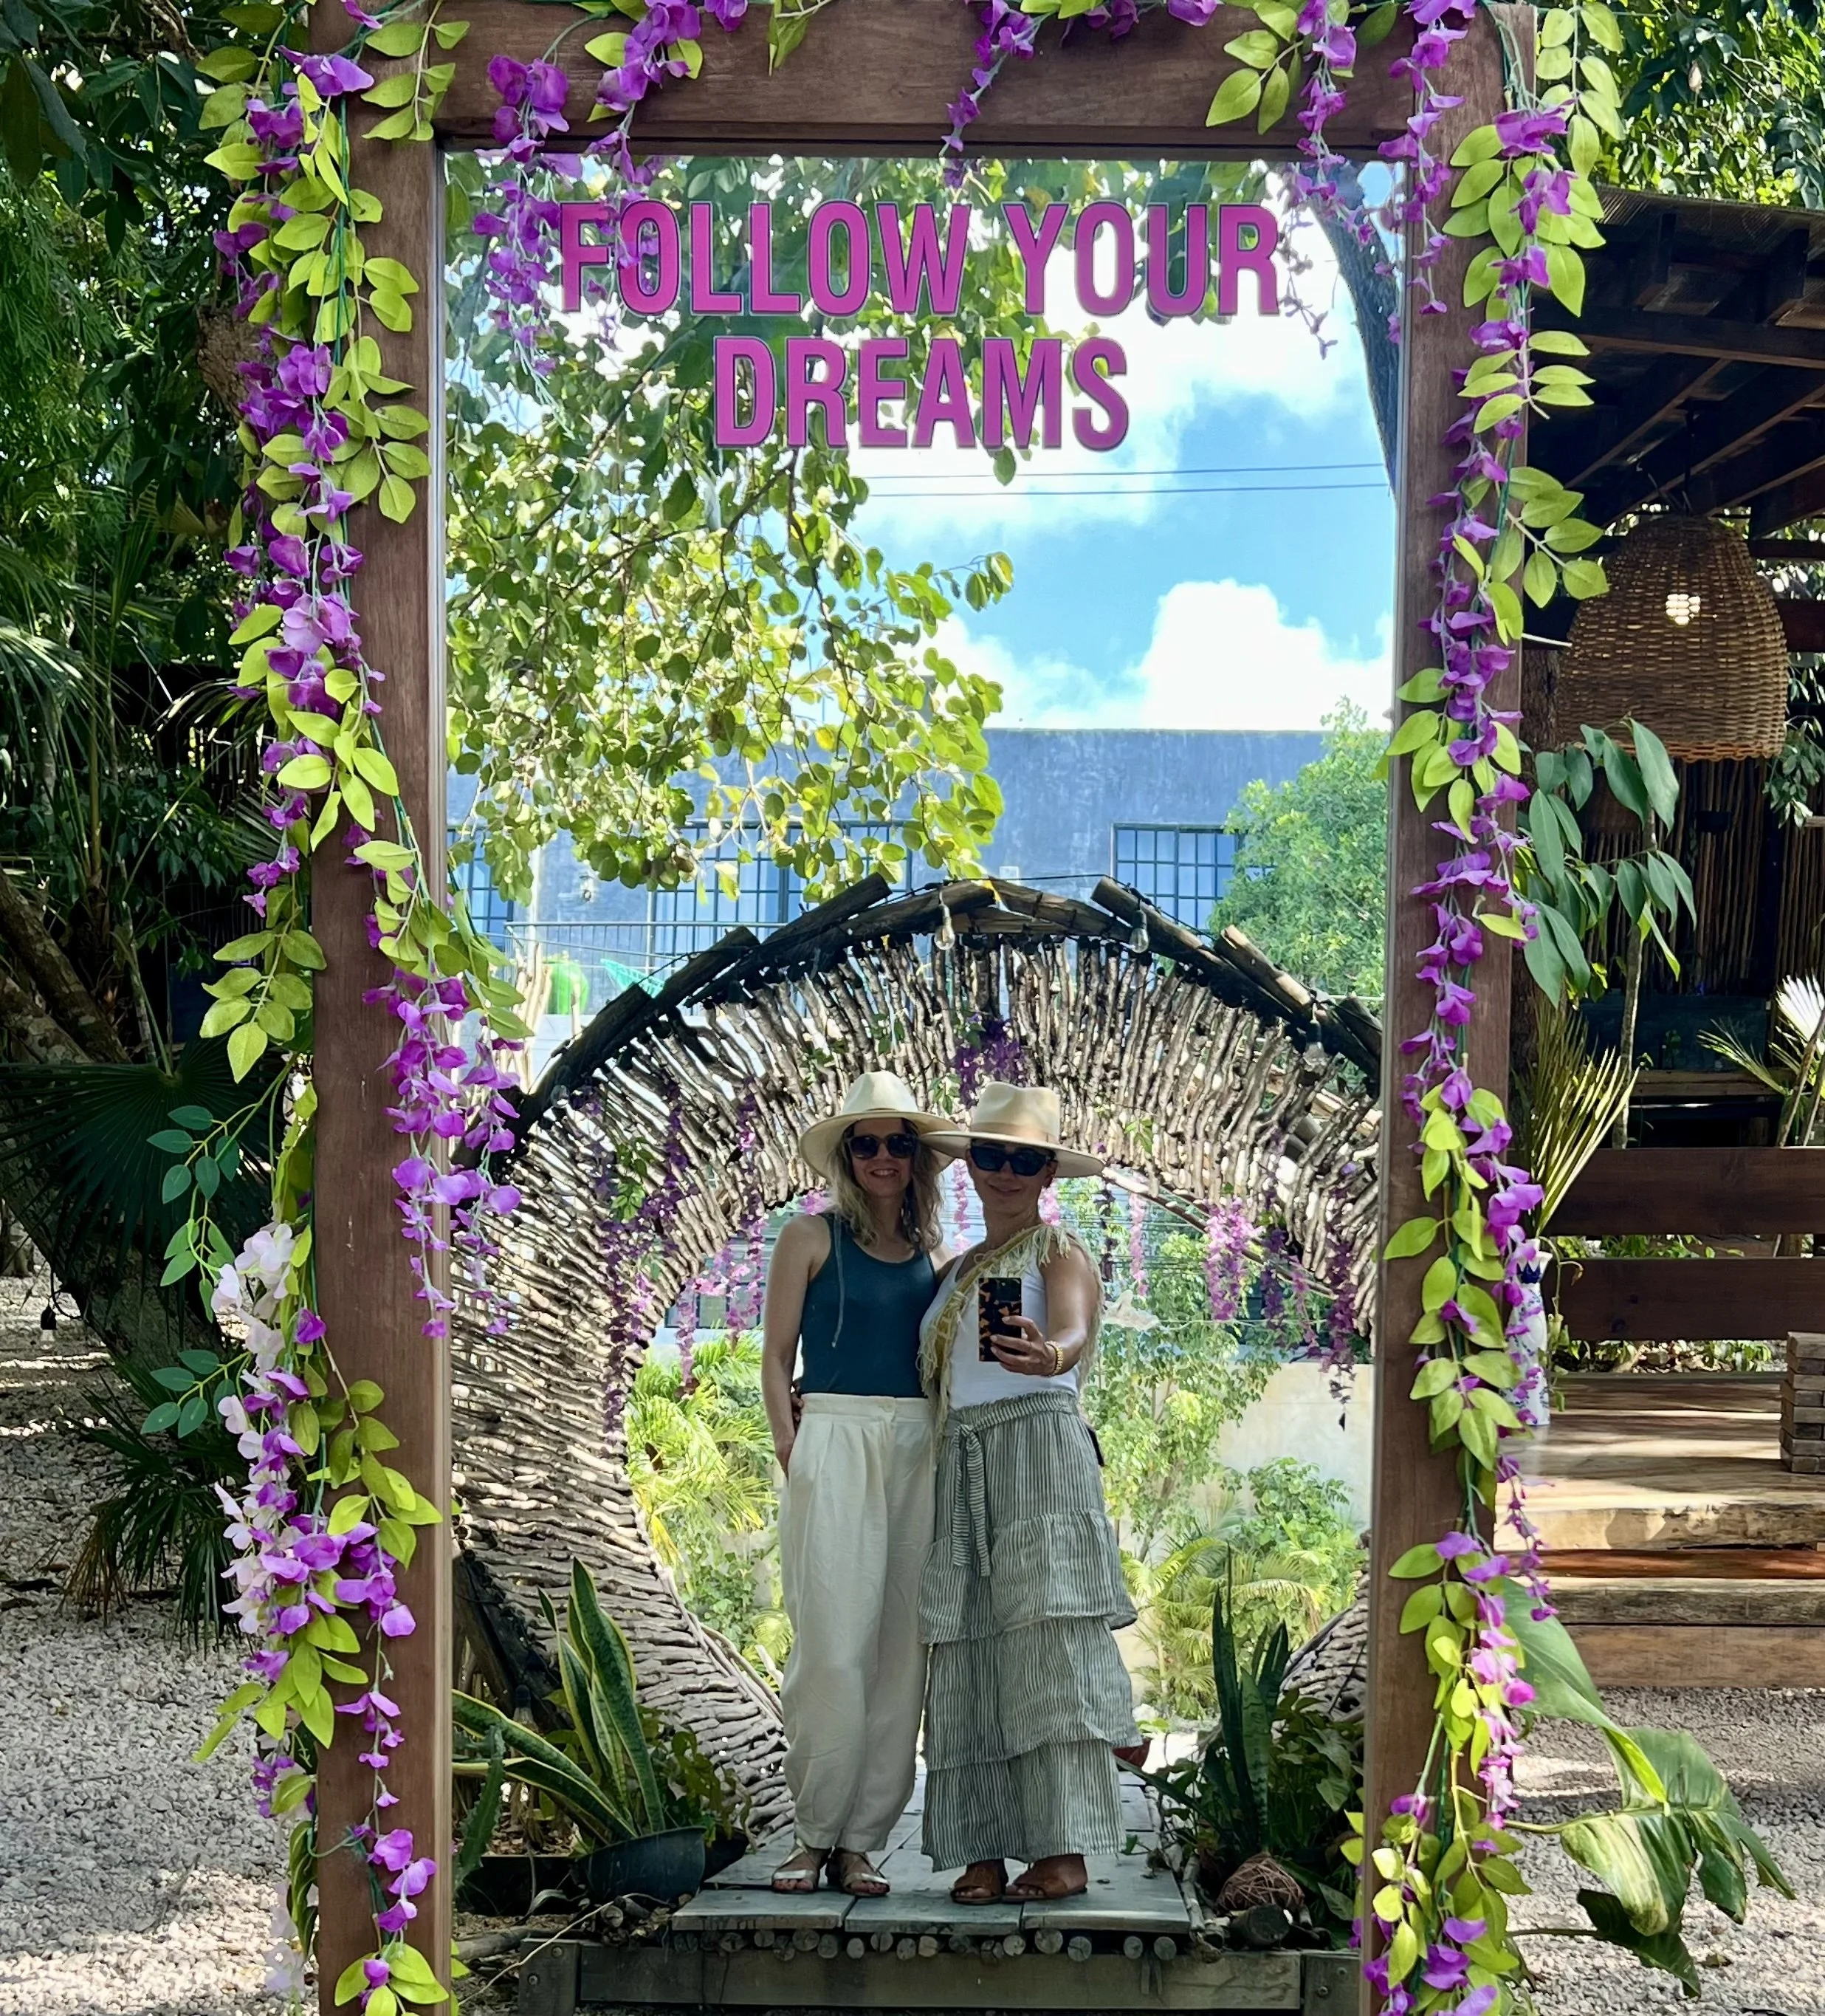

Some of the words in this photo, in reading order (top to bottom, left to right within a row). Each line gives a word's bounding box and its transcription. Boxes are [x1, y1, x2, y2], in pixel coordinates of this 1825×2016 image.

[560, 200, 971, 315] FOLLOW
[1001, 202, 1280, 316] YOUR
[713, 336, 1130, 450] DREAMS
